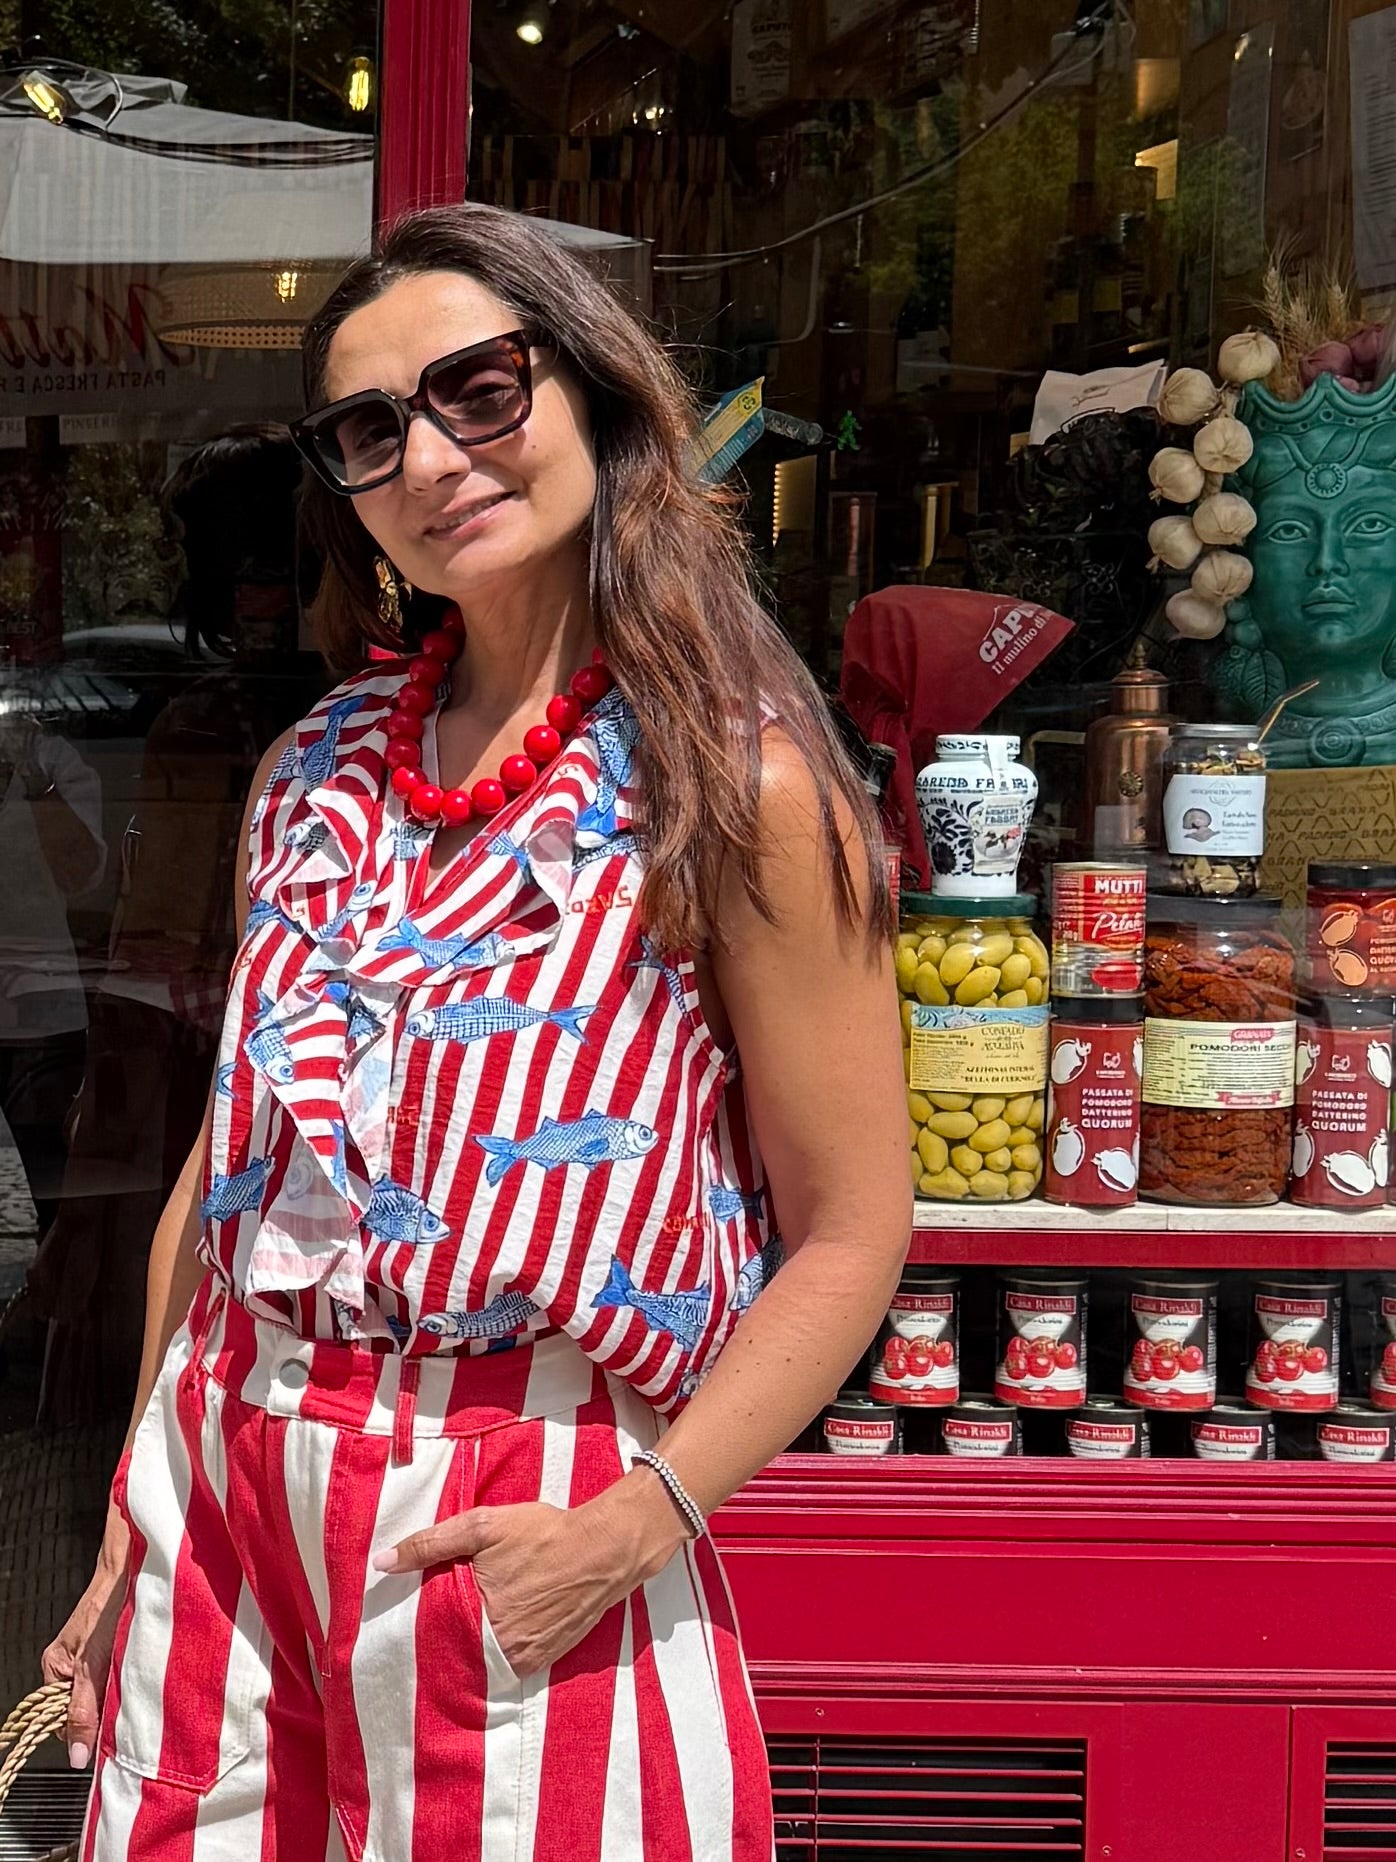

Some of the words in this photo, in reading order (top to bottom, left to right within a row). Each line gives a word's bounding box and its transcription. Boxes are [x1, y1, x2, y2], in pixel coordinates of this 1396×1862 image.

[1003, 628, 1039, 665] mulino
[1095, 879, 1143, 894] MUTTI
[1082, 1088, 1124, 1097] PASSATA
[1312, 1090, 1355, 1100] PASSATA
[1357, 1092, 1368, 1100] DI
[1081, 1098, 1133, 1107] POMODORO
[1312, 1101, 1368, 1111] POMODORO
[1081, 1108, 1133, 1117] DATTERINO
[1312, 1110, 1368, 1120] DATTERINO
[1081, 1118, 1133, 1129] QUORUM
[1311, 1120, 1367, 1132] QUORUM
